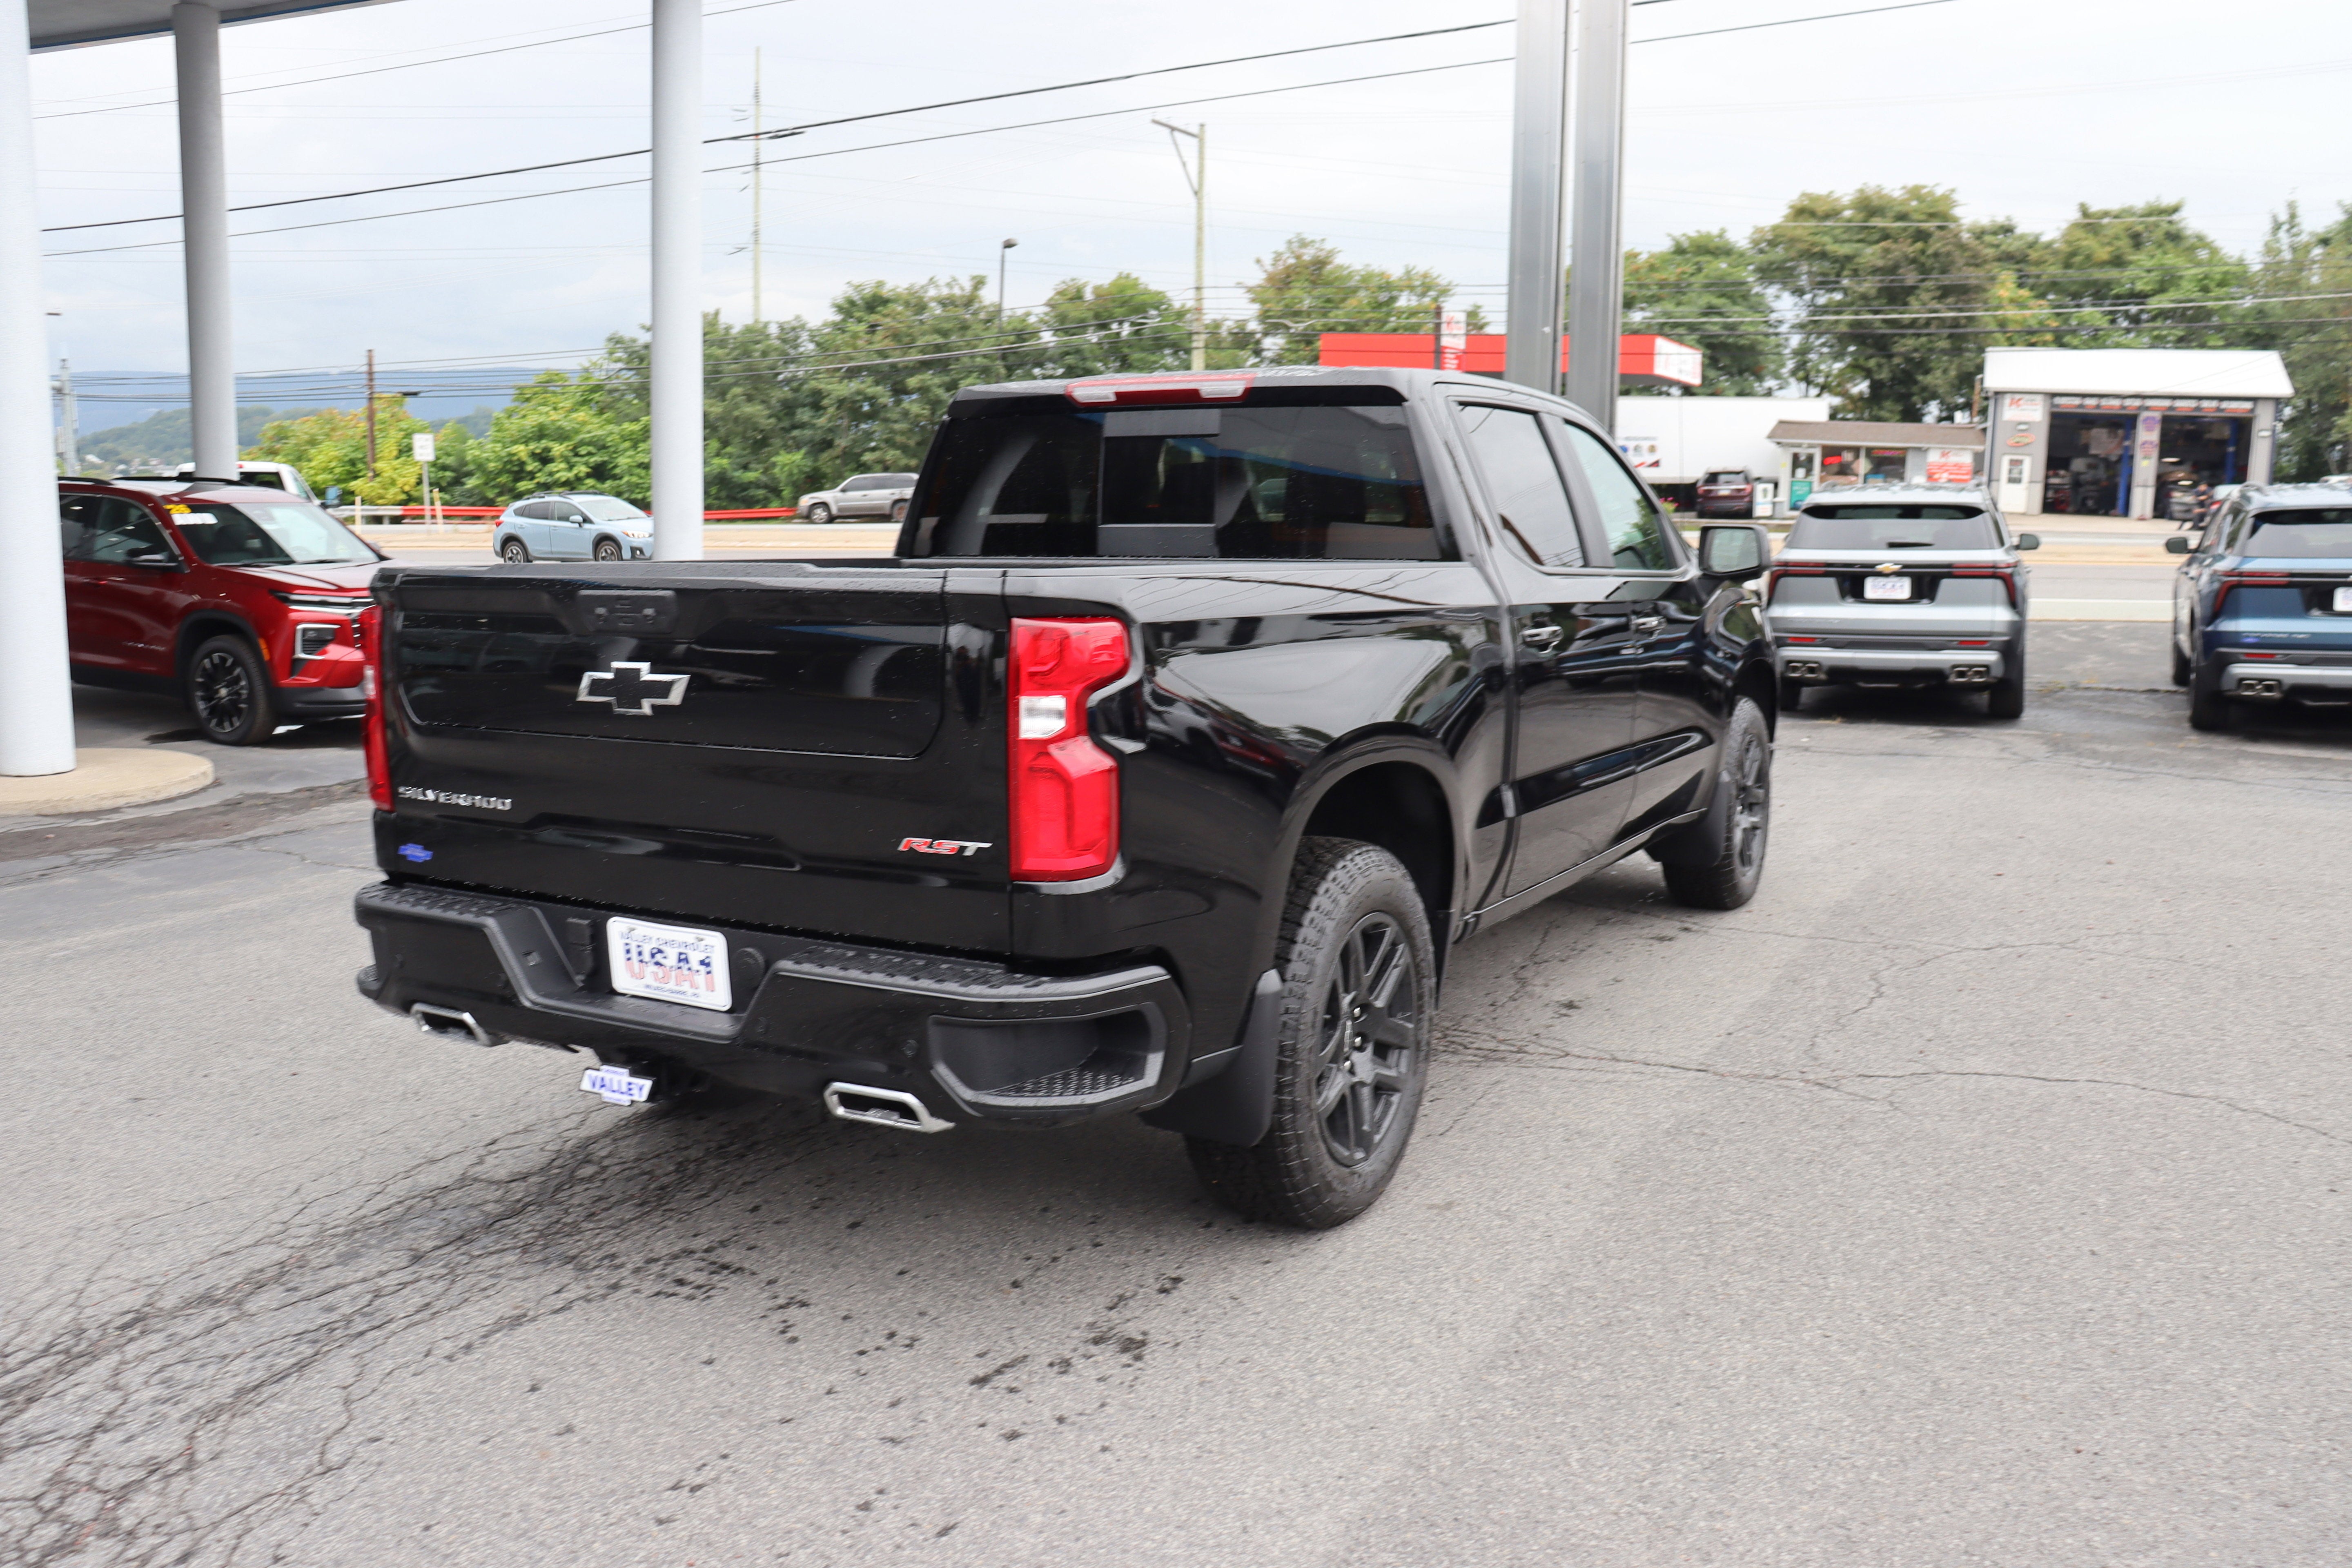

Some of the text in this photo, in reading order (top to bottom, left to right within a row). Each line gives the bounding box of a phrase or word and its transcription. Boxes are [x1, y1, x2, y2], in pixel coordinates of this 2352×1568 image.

[397, 786, 512, 811] SILVERADO
[897, 837, 993, 857] RST
[655, 937, 715, 953] CHEVROLET
[624, 942, 715, 992] USA1
[587, 1074, 645, 1098] VALLEY
